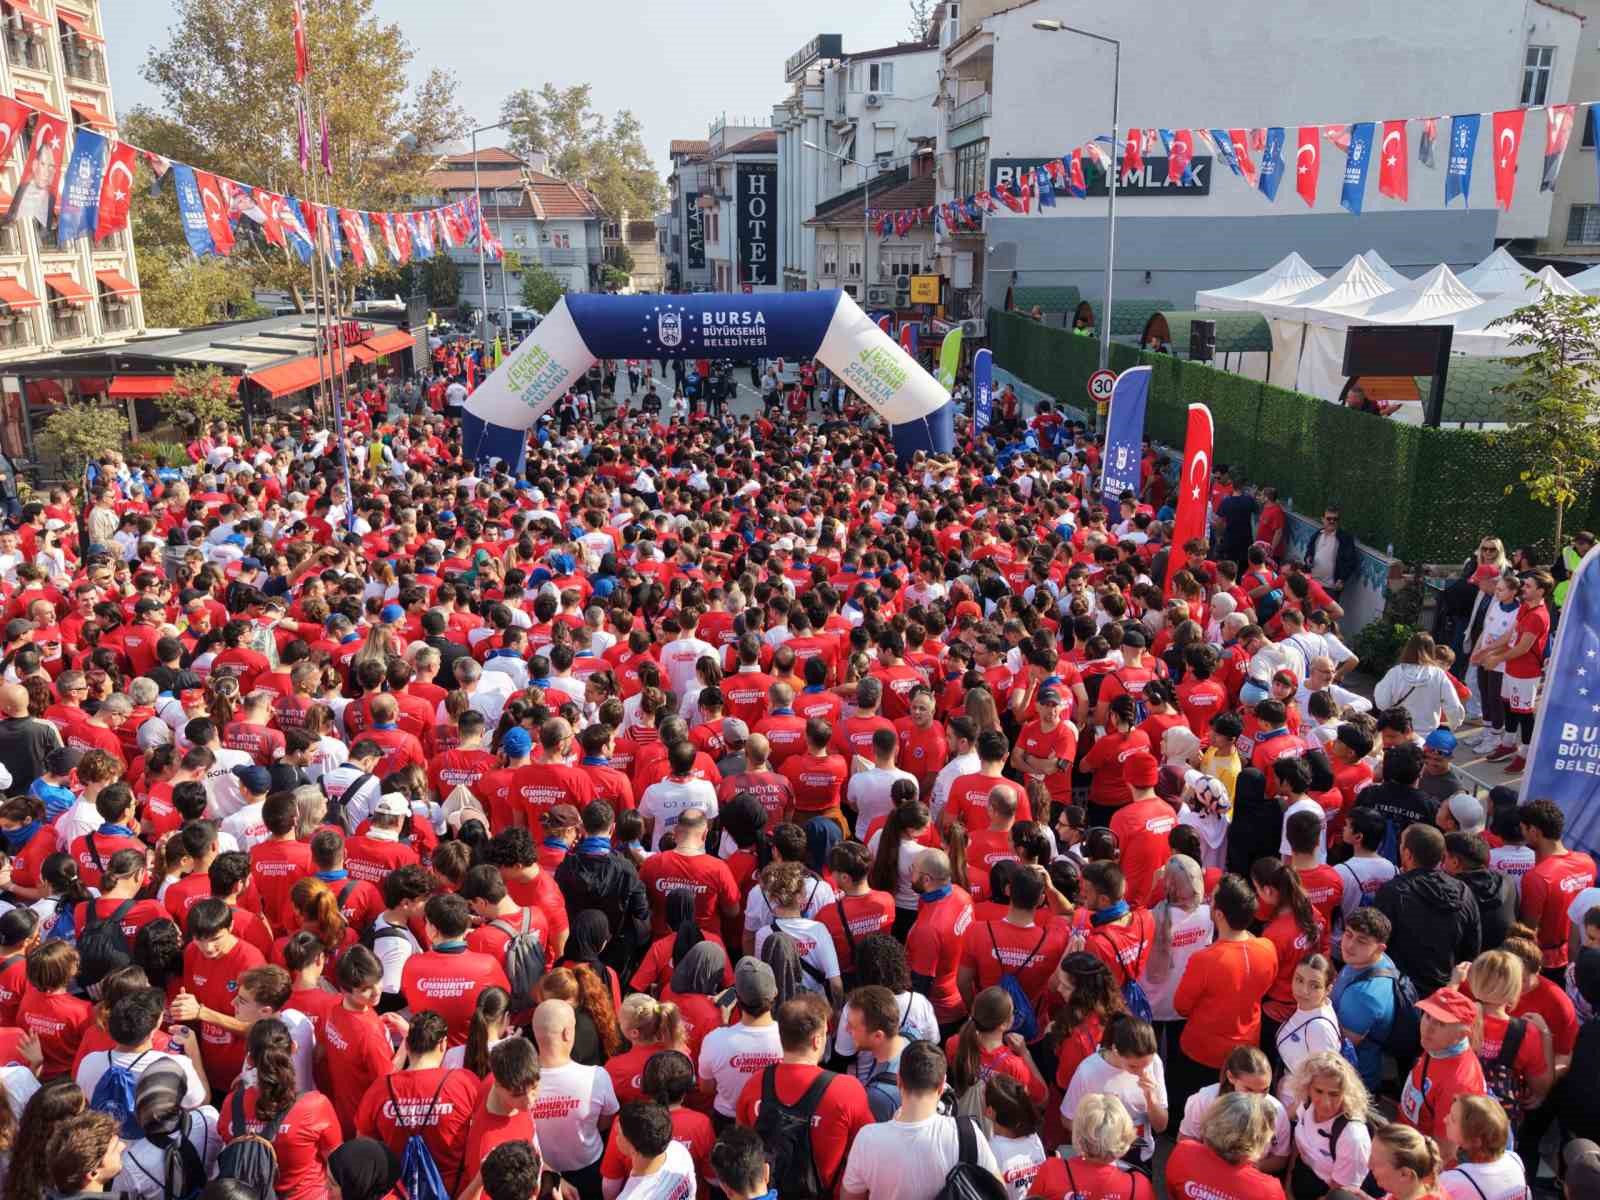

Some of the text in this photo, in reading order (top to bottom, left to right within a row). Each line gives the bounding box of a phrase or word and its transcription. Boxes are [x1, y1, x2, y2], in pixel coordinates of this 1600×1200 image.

[748, 174, 767, 284] HOTEL
[702, 311, 766, 325] BURSA
[704, 335, 768, 346] BELEDİYESİ
[1094, 379, 1113, 393] 30
[1558, 743, 1600, 758] BÜYÜ
[426, 988, 464, 999] KOŞUSU
